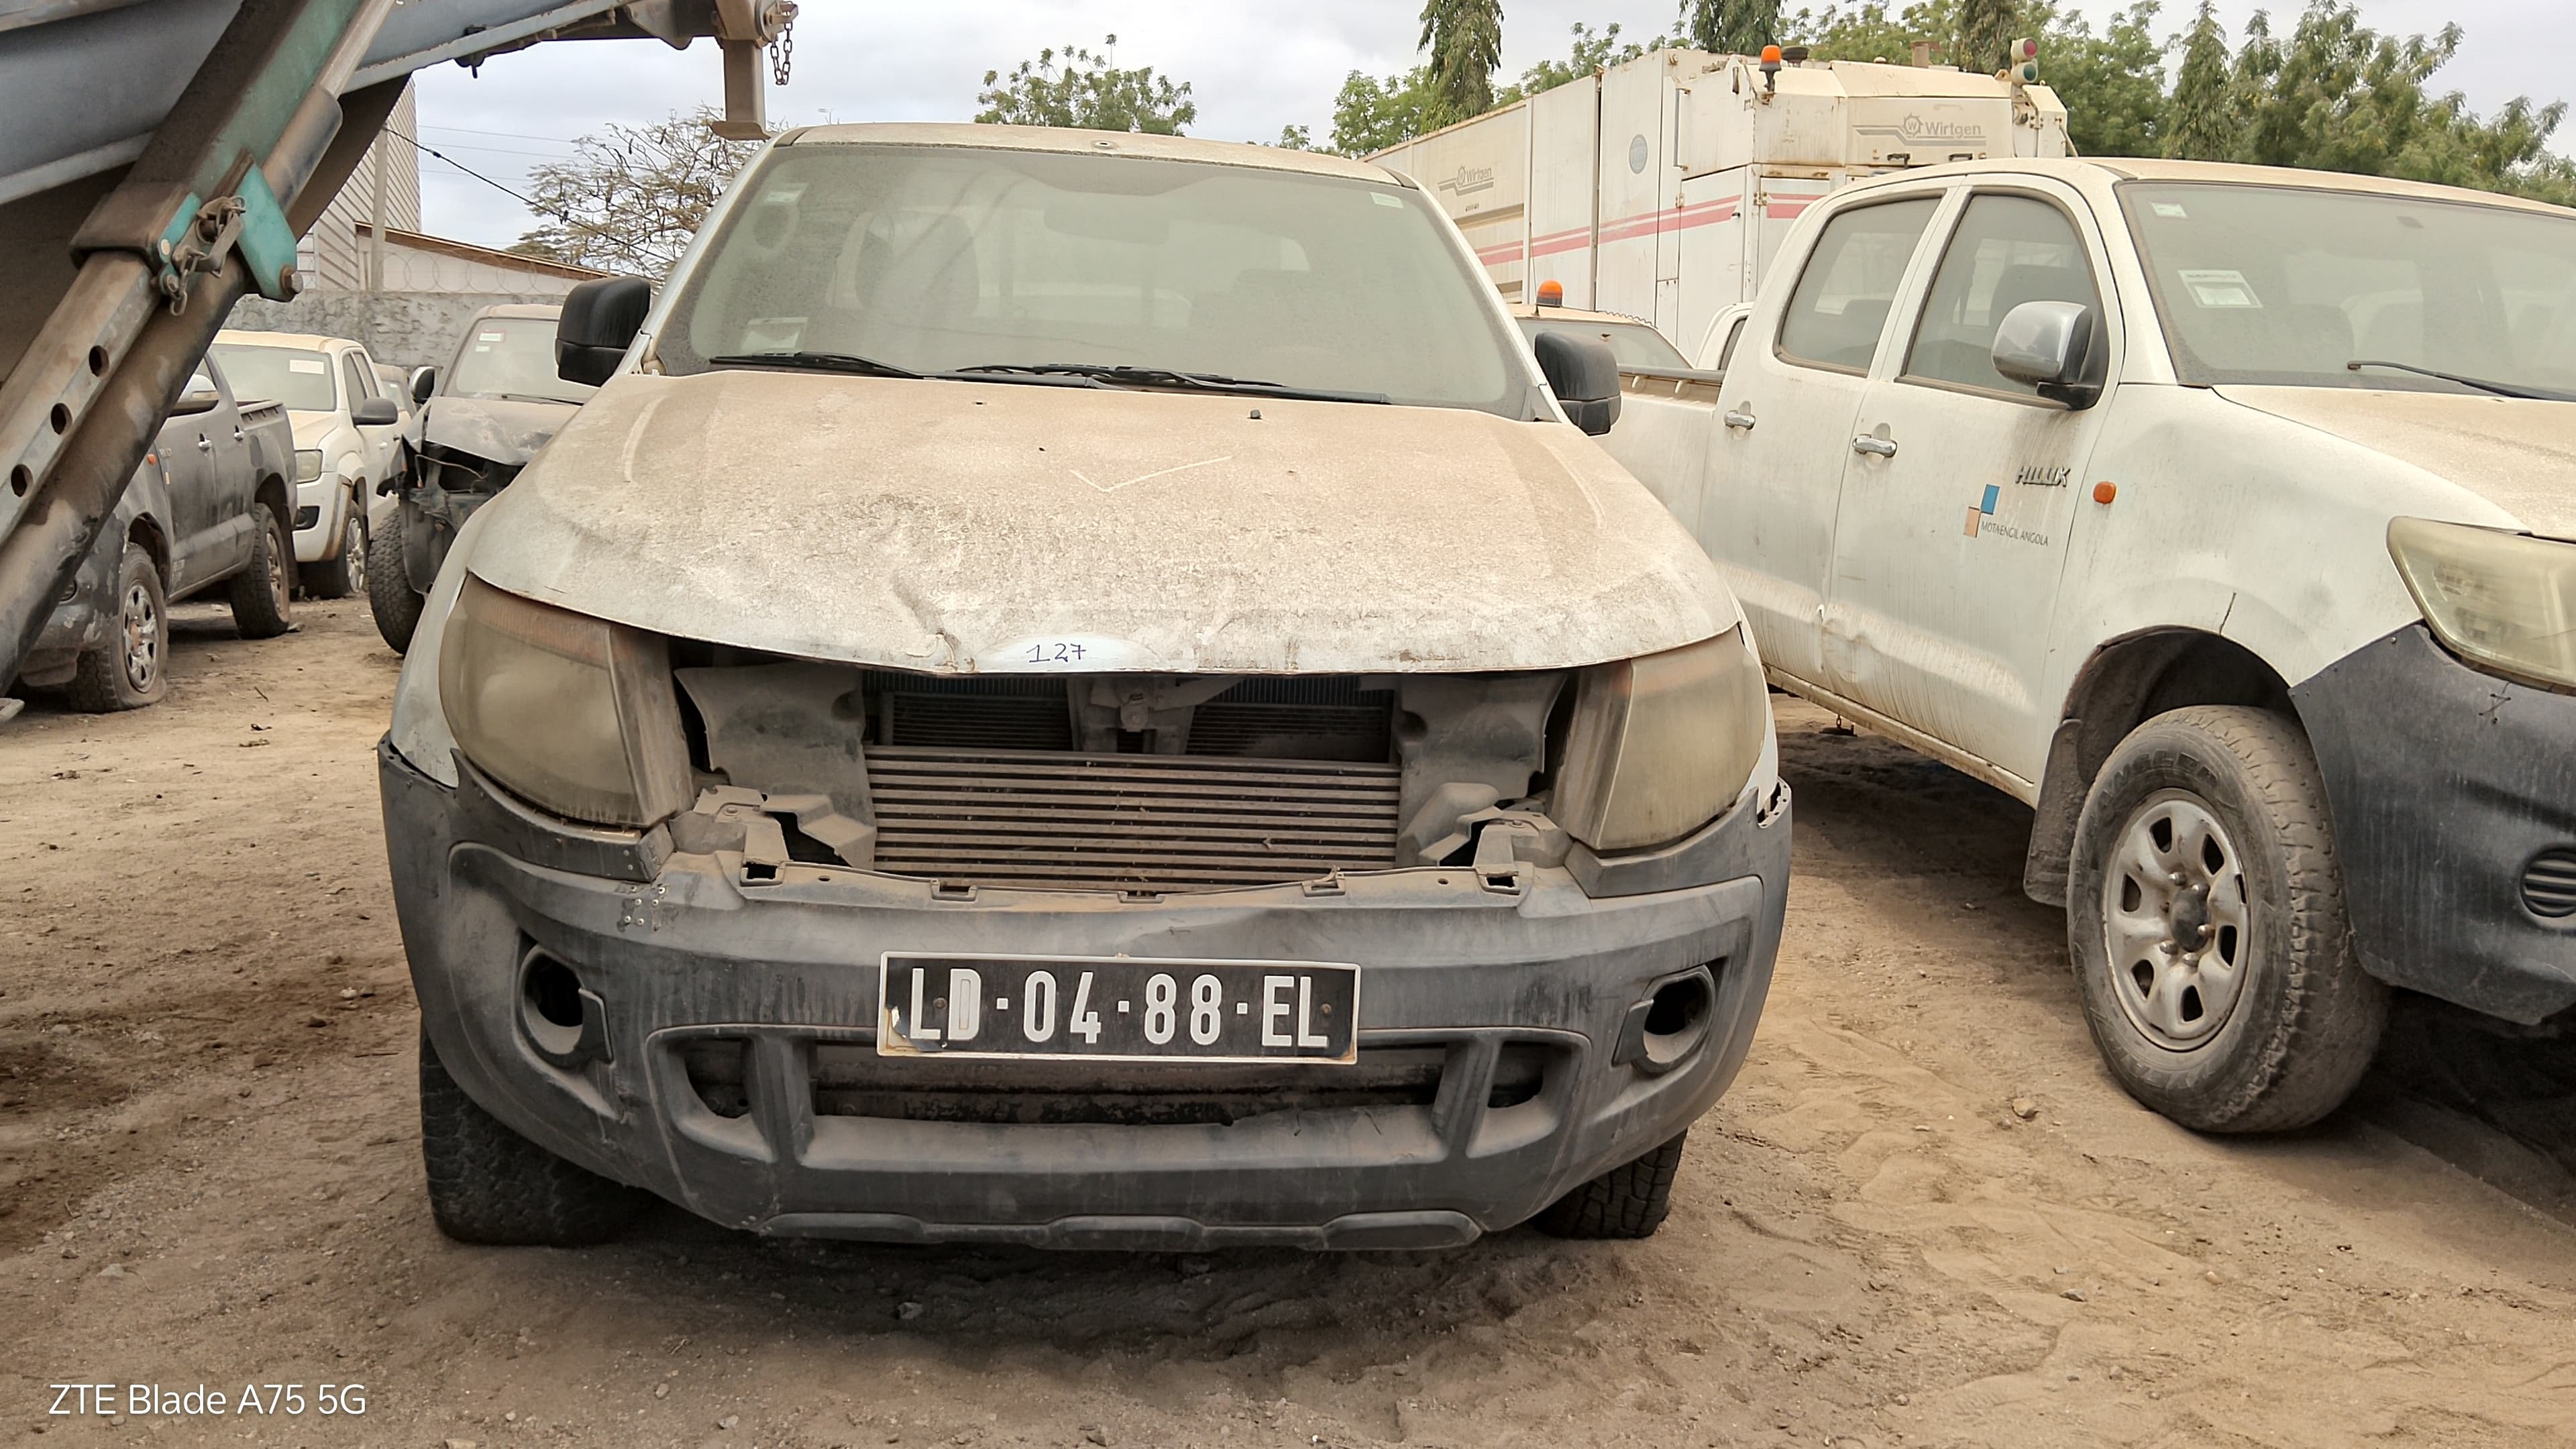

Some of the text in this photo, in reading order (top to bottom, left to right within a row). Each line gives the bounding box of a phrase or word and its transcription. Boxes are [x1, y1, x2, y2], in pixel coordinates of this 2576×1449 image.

[1925, 121, 1982, 138] Wirtgen
[2015, 464, 2072, 488] HILUX
[2020, 530, 2048, 546] ANGOLA
[1026, 643, 1087, 663] 127
